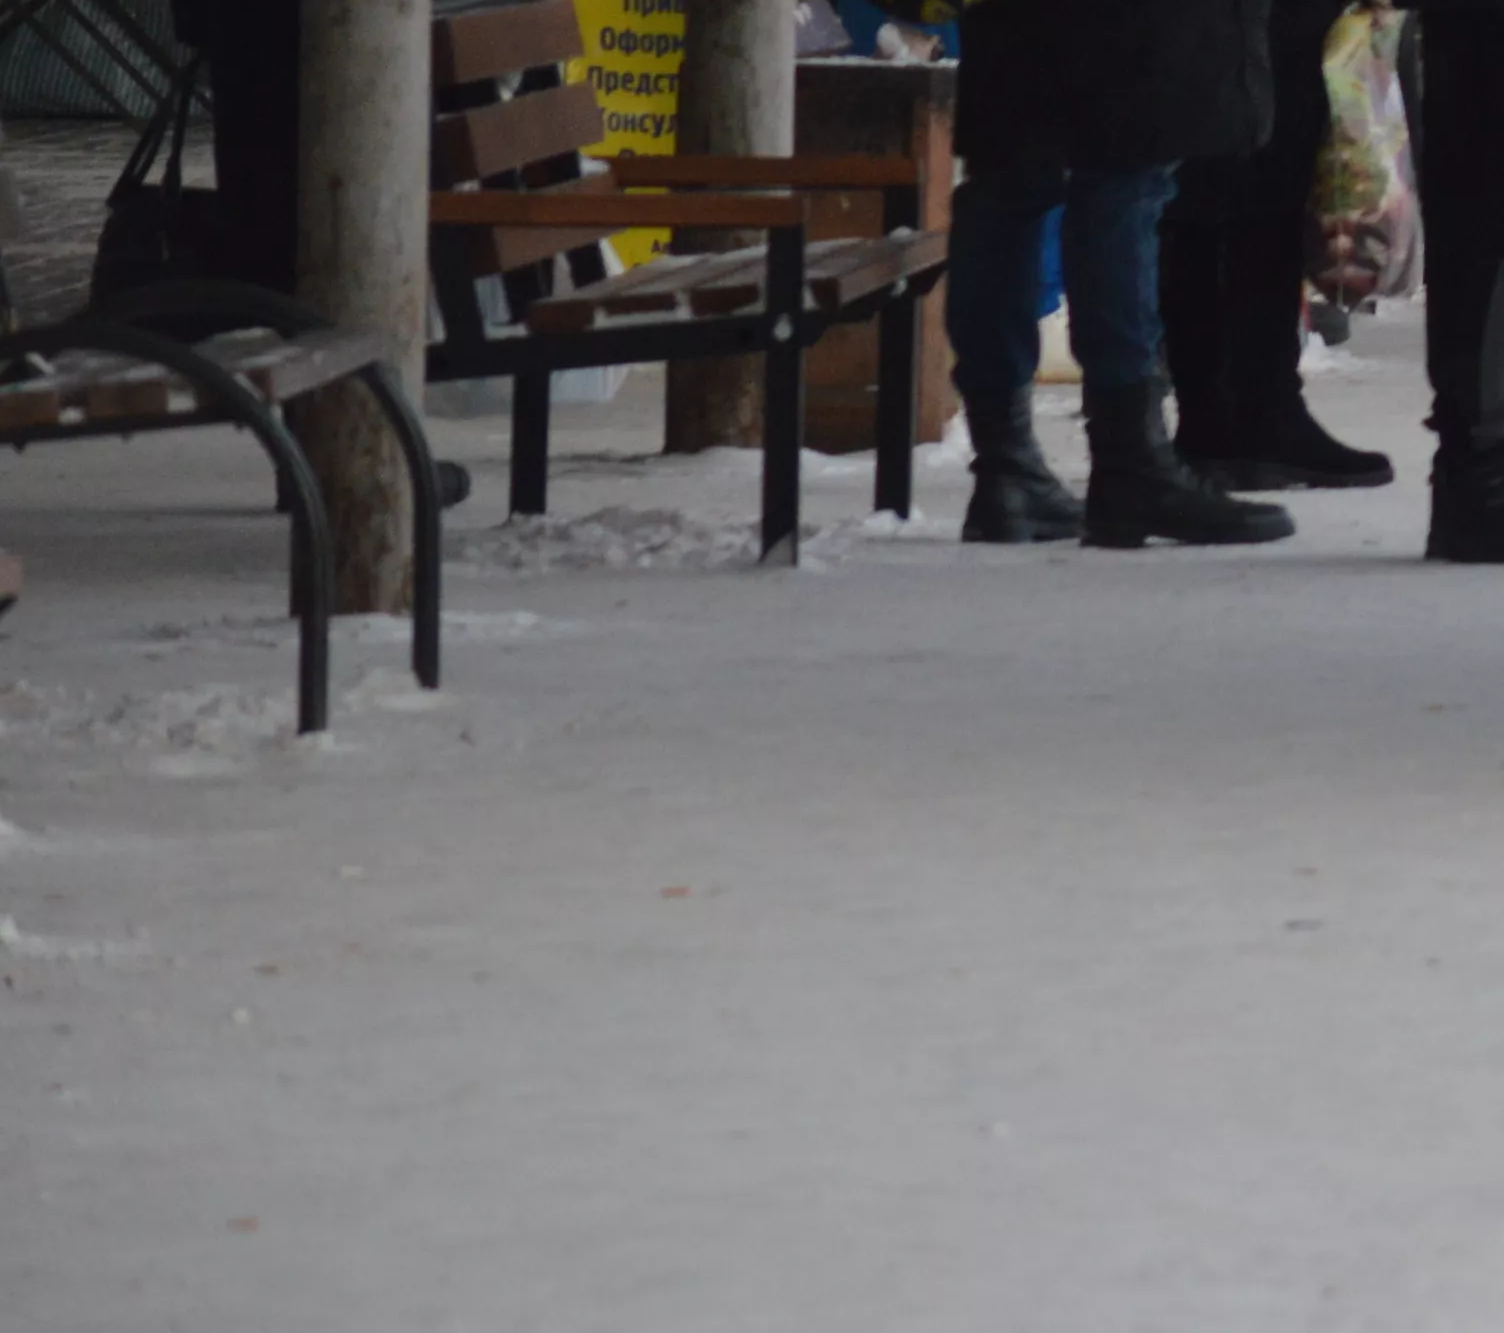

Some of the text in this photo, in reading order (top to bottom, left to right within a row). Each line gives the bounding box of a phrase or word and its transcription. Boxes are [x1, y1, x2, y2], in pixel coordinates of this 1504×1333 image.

[600, 27, 685, 57] Оформ
[588, 66, 680, 97] Предст
[601, 107, 678, 138] онсул
